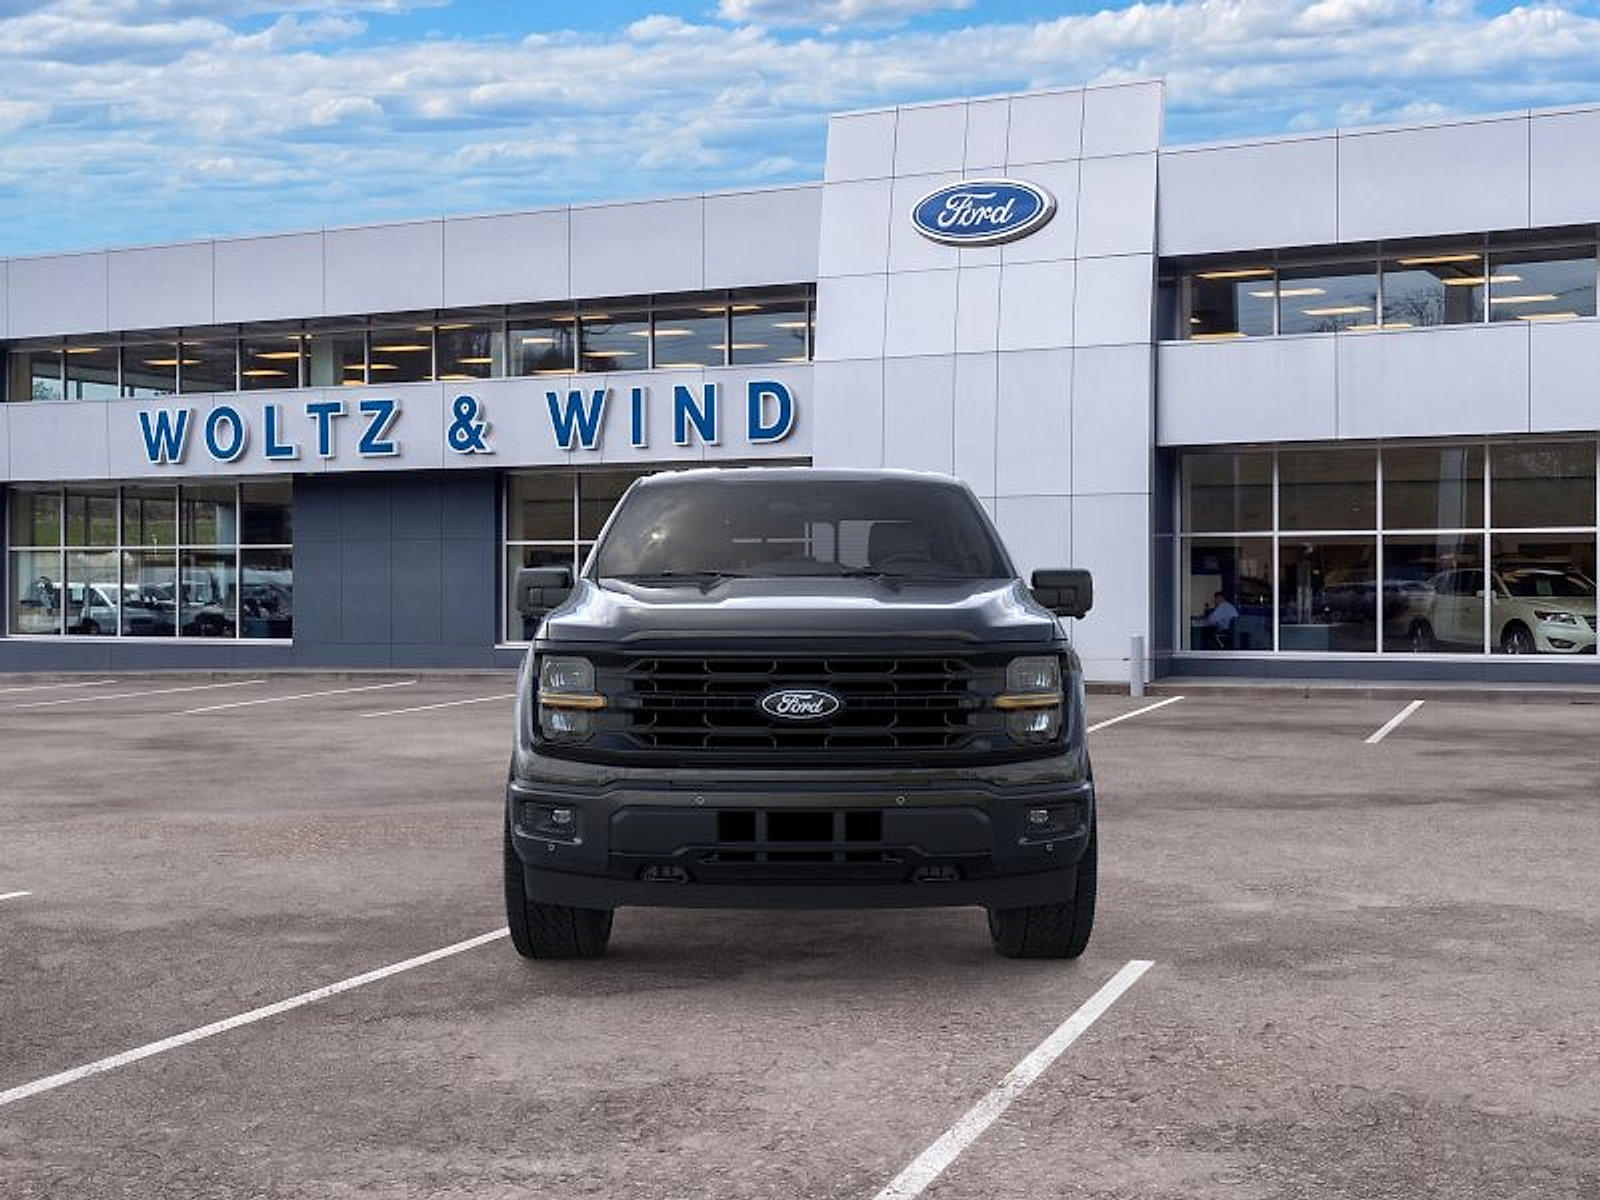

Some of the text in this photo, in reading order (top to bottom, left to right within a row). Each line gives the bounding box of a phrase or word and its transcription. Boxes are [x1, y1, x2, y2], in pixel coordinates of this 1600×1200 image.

[937, 191, 1016, 228] Ford
[138, 379, 798, 464] WOLTZ & WIND
[776, 693, 824, 714] Ford
